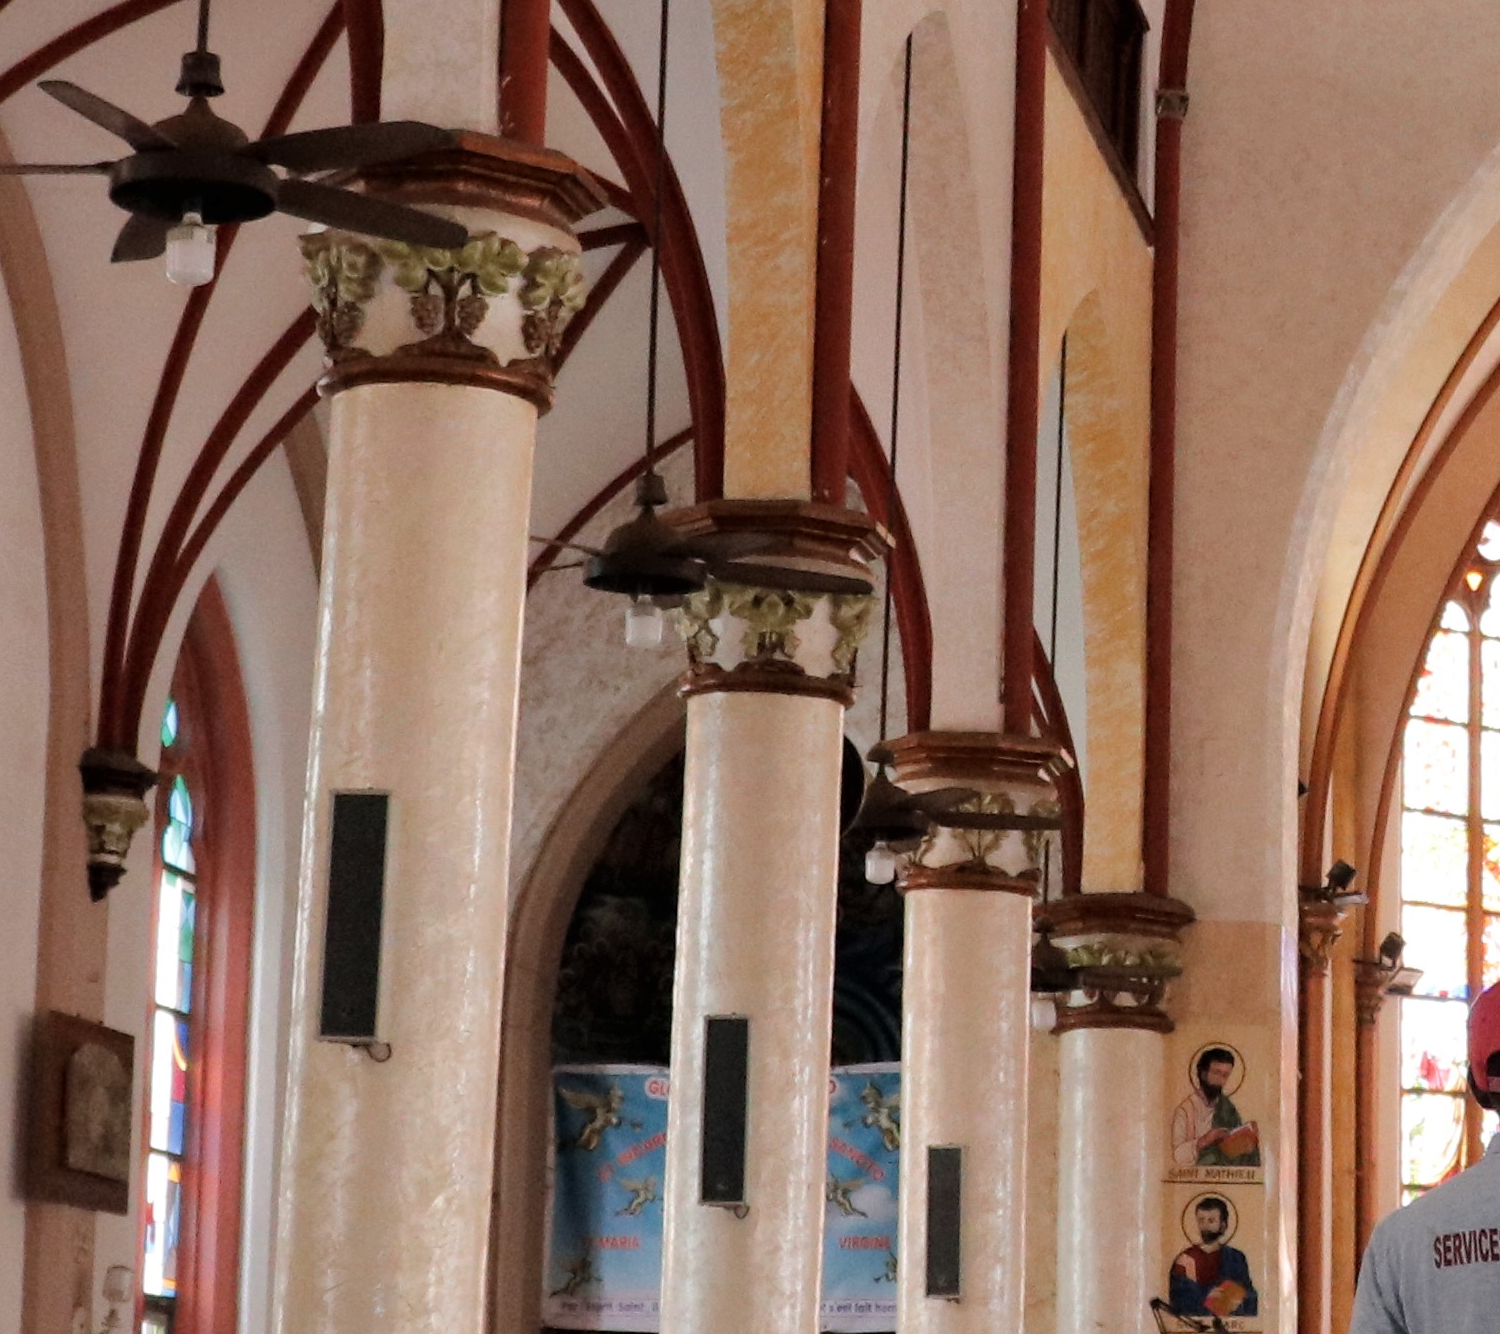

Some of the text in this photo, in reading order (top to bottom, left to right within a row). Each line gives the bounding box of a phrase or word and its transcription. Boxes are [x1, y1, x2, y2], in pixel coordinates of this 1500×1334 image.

[1168, 1168, 1256, 1180] SAINT MATHIEU
[839, 1236, 891, 1251] VIRGINE
